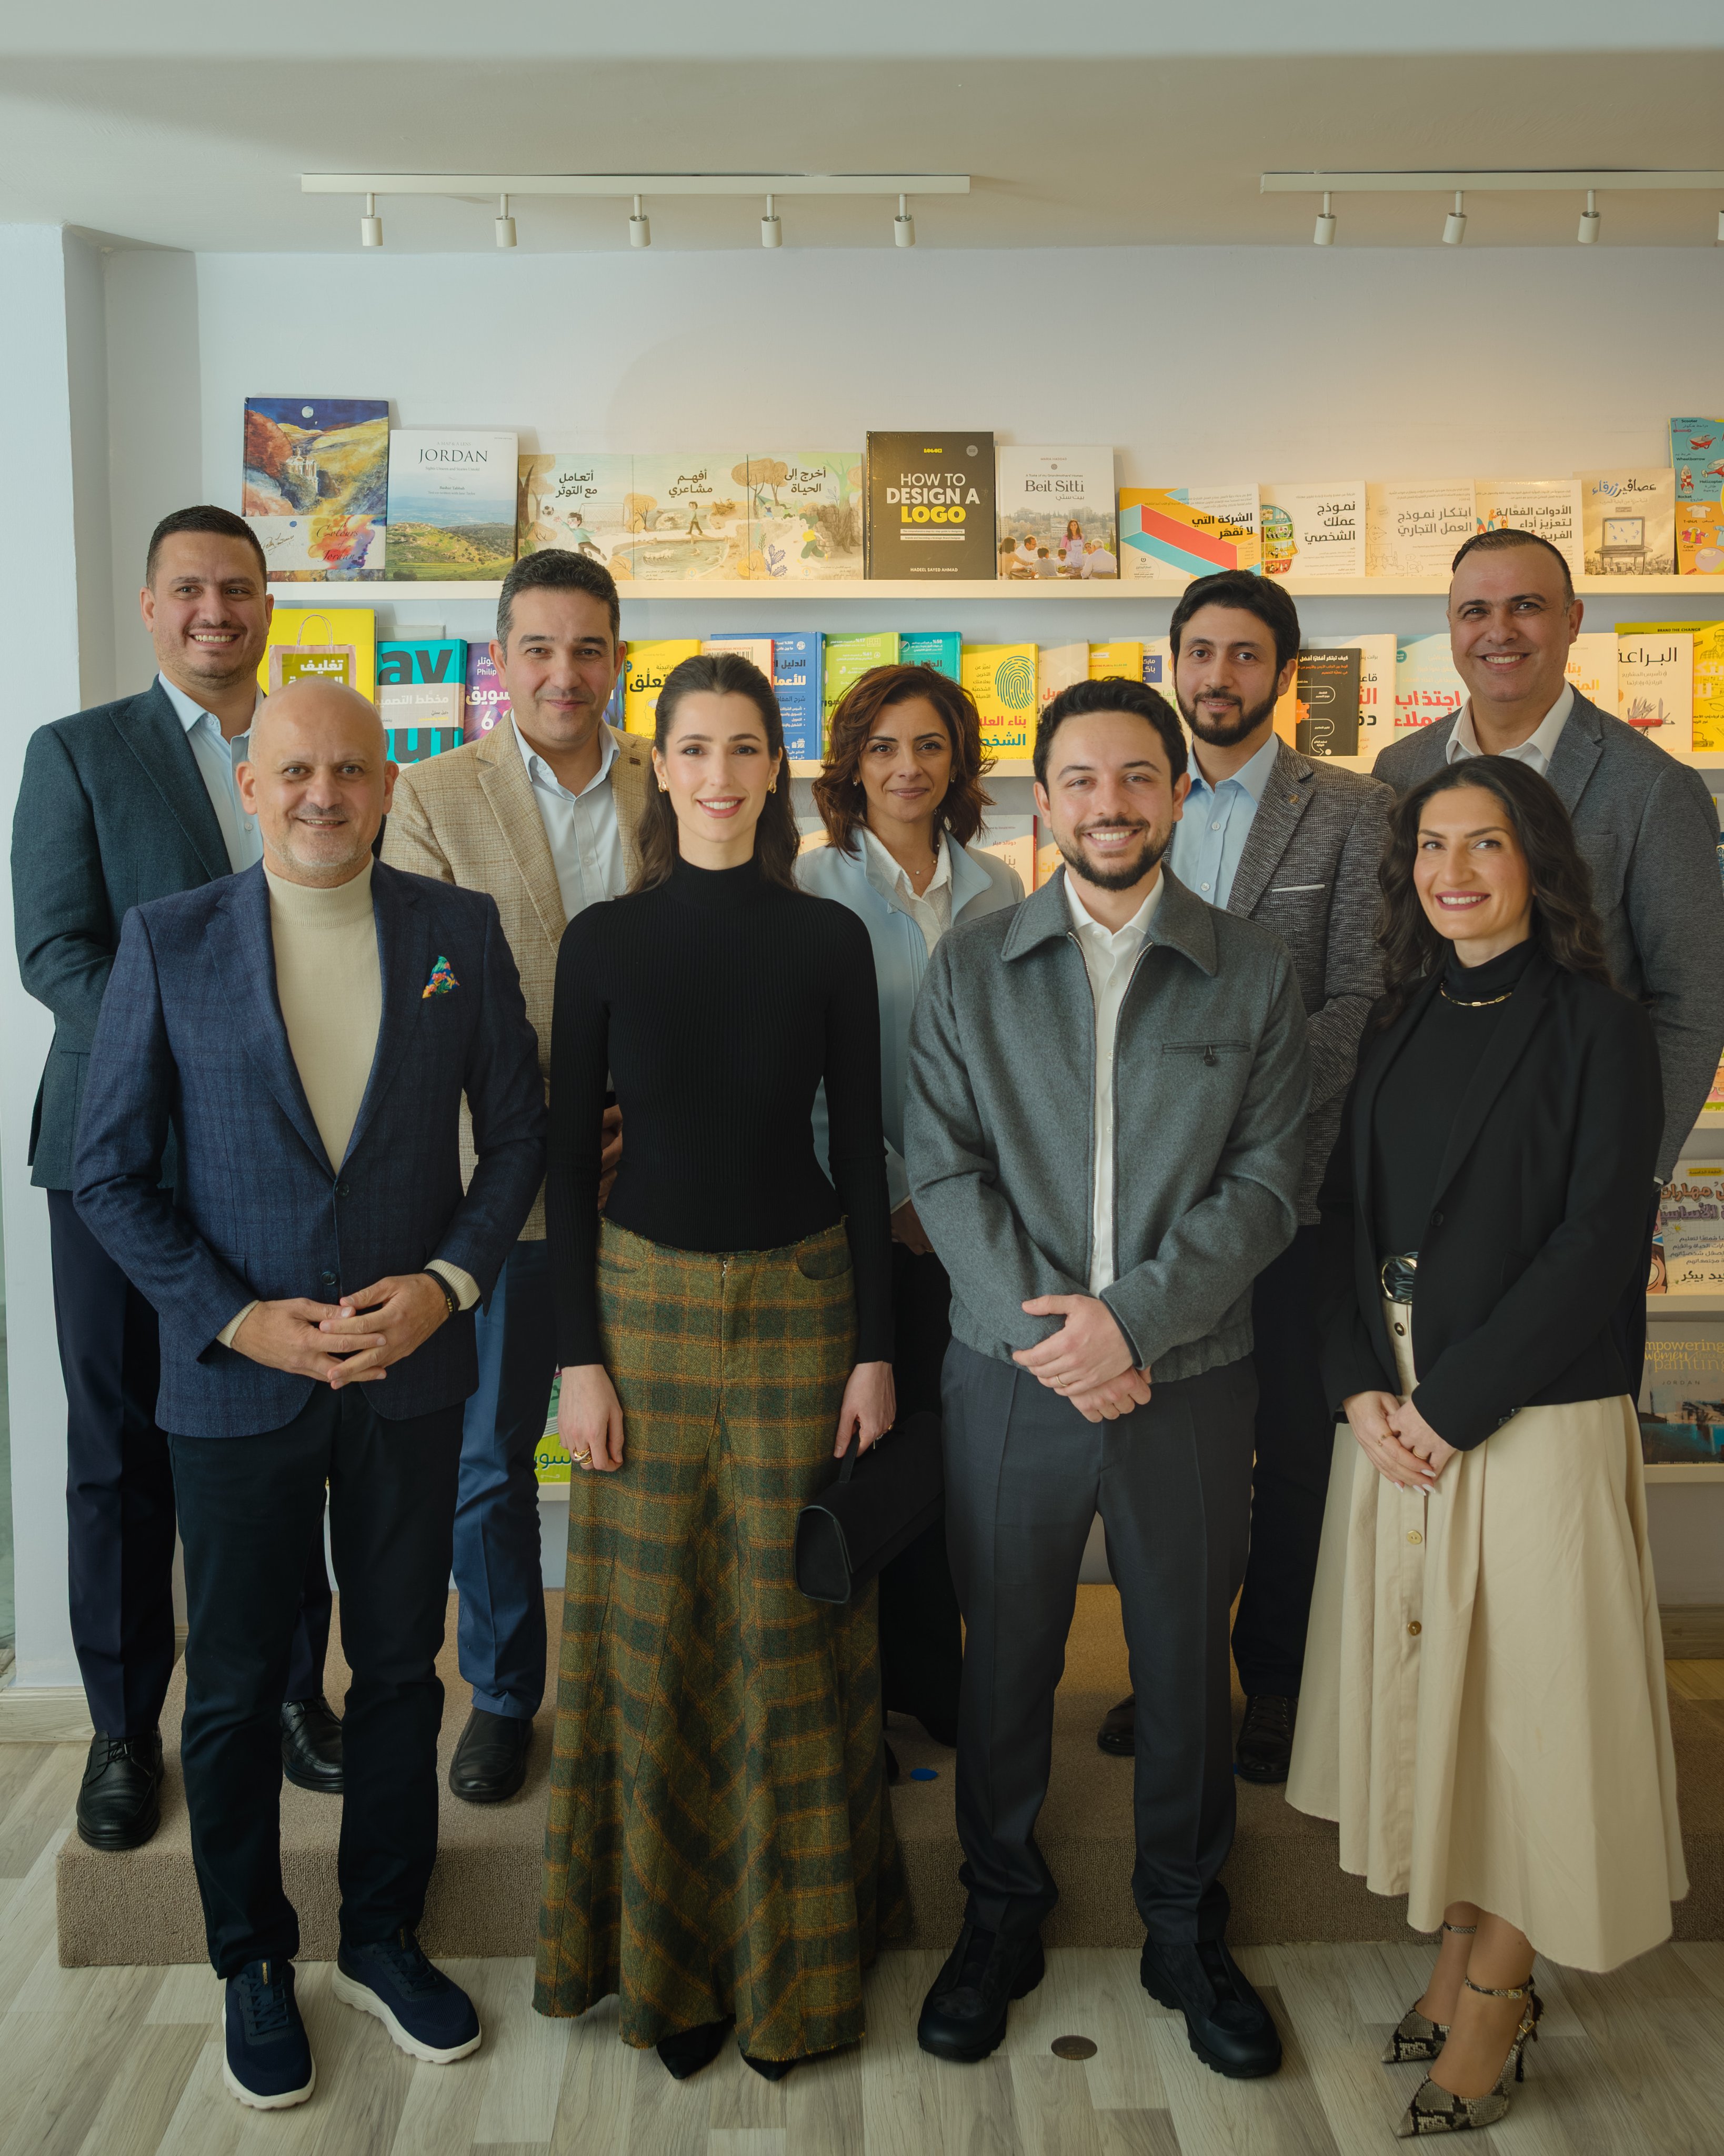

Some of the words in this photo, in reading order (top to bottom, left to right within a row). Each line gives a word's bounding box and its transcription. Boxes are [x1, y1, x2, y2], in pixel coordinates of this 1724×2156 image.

[418, 449, 488, 464] JORDAN
[677, 468, 707, 484] أفهم
[784, 468, 797, 481] إلى
[800, 466, 826, 482] أخرج
[900, 473, 941, 486] HOW
[945, 473, 966, 486] TO
[668, 484, 713, 498] مشاعري
[790, 483, 821, 495] الحياة
[1025, 480, 1053, 492] Beit
[1055, 480, 1085, 492] Sitti
[1592, 480, 1619, 496] زرقاء
[1612, 478, 1656, 497] عصافير
[585, 488, 597, 498] مع
[886, 487, 960, 504] DESIGN
[965, 488, 980, 504] A
[901, 506, 966, 523] LOGO
[1317, 501, 1355, 516] نموذج
[1438, 506, 1471, 521] ابتكار
[1536, 504, 1571, 517] الأدوات
[1191, 515, 1215, 527] التي
[1218, 512, 1252, 525] الشركة
[1324, 516, 1356, 526] عملك
[1398, 509, 1435, 524] نموذج
[1519, 516, 1536, 528] أداء
[316, 522, 358, 537] Colours
[1246, 526, 1253, 535] لا
[1440, 522, 1472, 535] العمل
[1539, 518, 1572, 530] لتعزيز
[1541, 530, 1572, 542] الفريق
[337, 540, 344, 548] of
[317, 545, 355, 563] Jordan
[300, 660, 344, 674] تغليف
[477, 656, 494, 667] وتلر
[781, 659, 806, 670] الدليل
[774, 674, 806, 686] للأعما
[1395, 691, 1461, 710] اجتذاب
[1007, 715, 1026, 728] بناء
[1660, 1182, 1713, 1202] مهارات
[1645, 1339, 1724, 1353] mpowering
